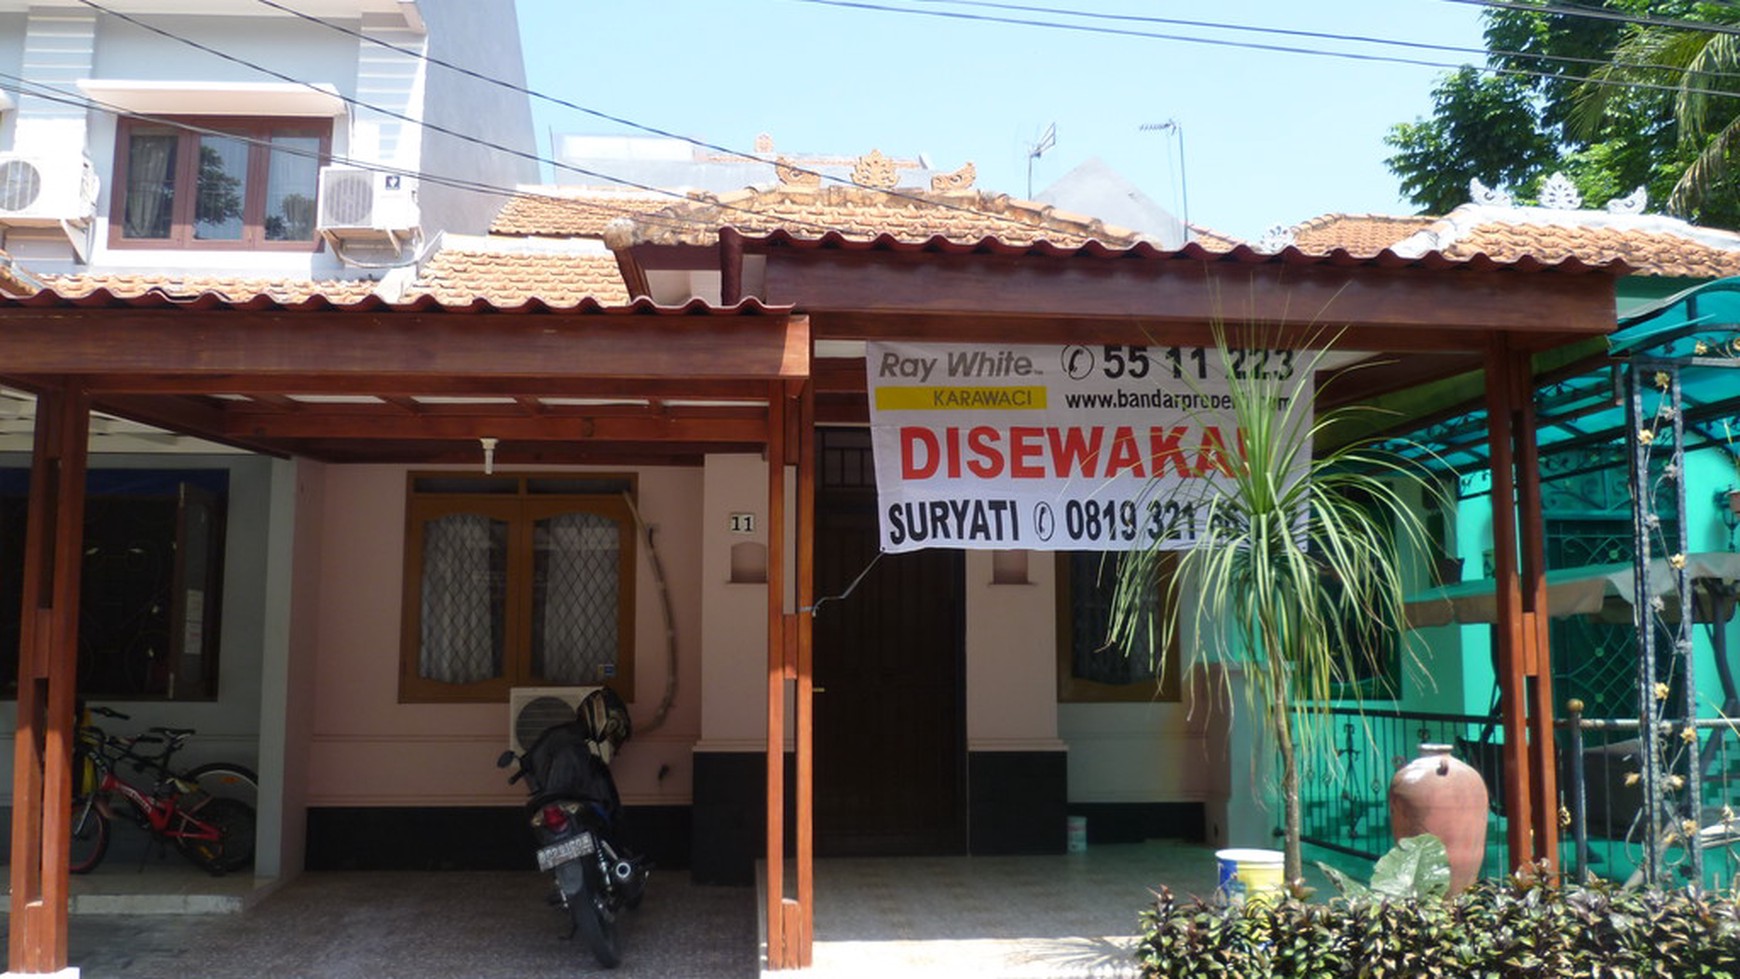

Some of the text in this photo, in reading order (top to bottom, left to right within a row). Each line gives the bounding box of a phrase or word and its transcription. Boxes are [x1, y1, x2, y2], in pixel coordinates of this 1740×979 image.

[879, 351, 1033, 382] Ray White
[1103, 345, 1294, 381] 55 11 223
[933, 389, 1032, 407] KARAWACI
[731, 516, 753, 532] 11
[889, 499, 1020, 544] SURYATI
[1066, 499, 1137, 541] 0819
[1148, 499, 1196, 541] 321
